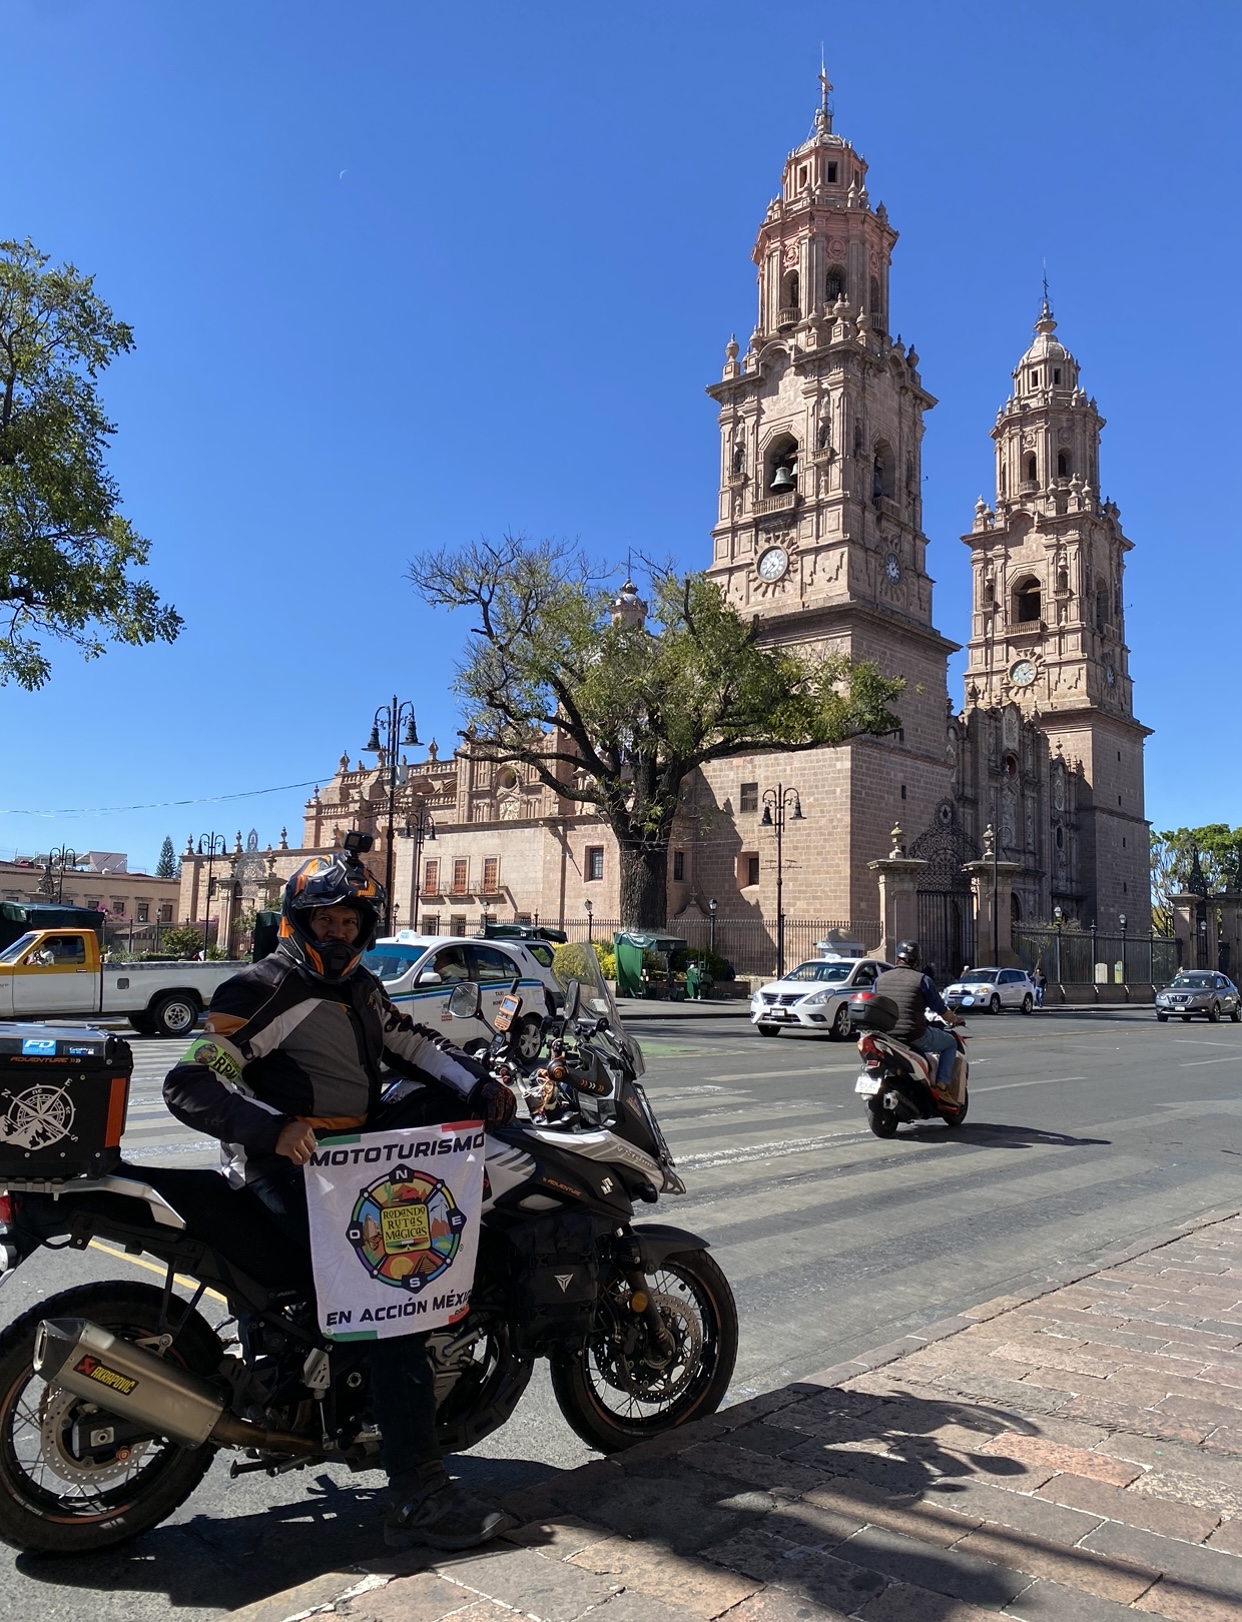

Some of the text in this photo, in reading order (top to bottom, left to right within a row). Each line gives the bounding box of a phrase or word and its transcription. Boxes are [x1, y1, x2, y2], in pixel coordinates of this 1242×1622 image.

[309, 1132, 485, 1167] MOTOTURISMO
[395, 1169, 408, 1180] N
[547, 1178, 581, 1196] ADVENTURE
[452, 1215, 462, 1226] E
[349, 1229, 361, 1240] O
[409, 1277, 421, 1288] S
[326, 1310, 352, 1327] EN
[359, 1297, 428, 1323] ACCIÓN
